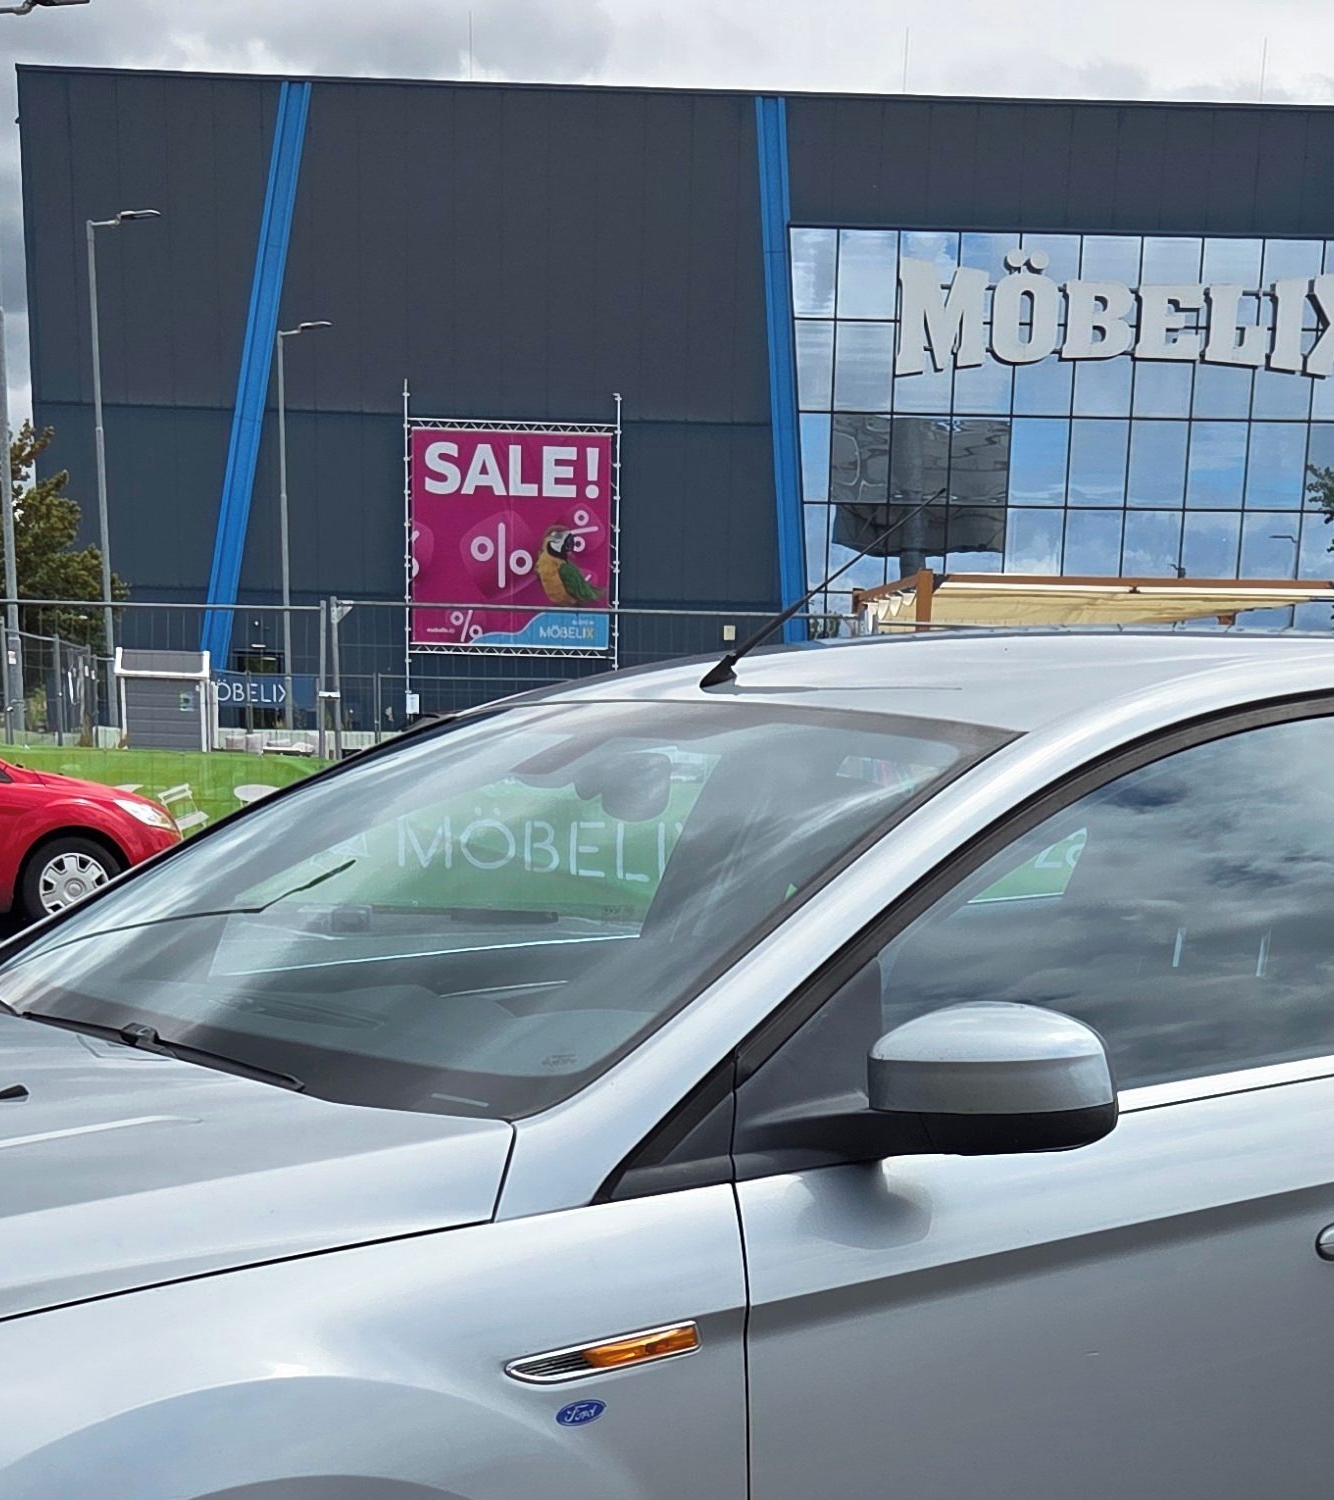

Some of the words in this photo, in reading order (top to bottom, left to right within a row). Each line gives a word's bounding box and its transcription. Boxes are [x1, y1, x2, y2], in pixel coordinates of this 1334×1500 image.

[424, 440, 600, 500] SALE!
[470, 522, 533, 589] %
[539, 625, 595, 640] MÖBELIX
[217, 679, 287, 703] ÖBELI
[395, 806, 684, 883] MÖBELI
[563, 1402, 600, 1424] Ford
